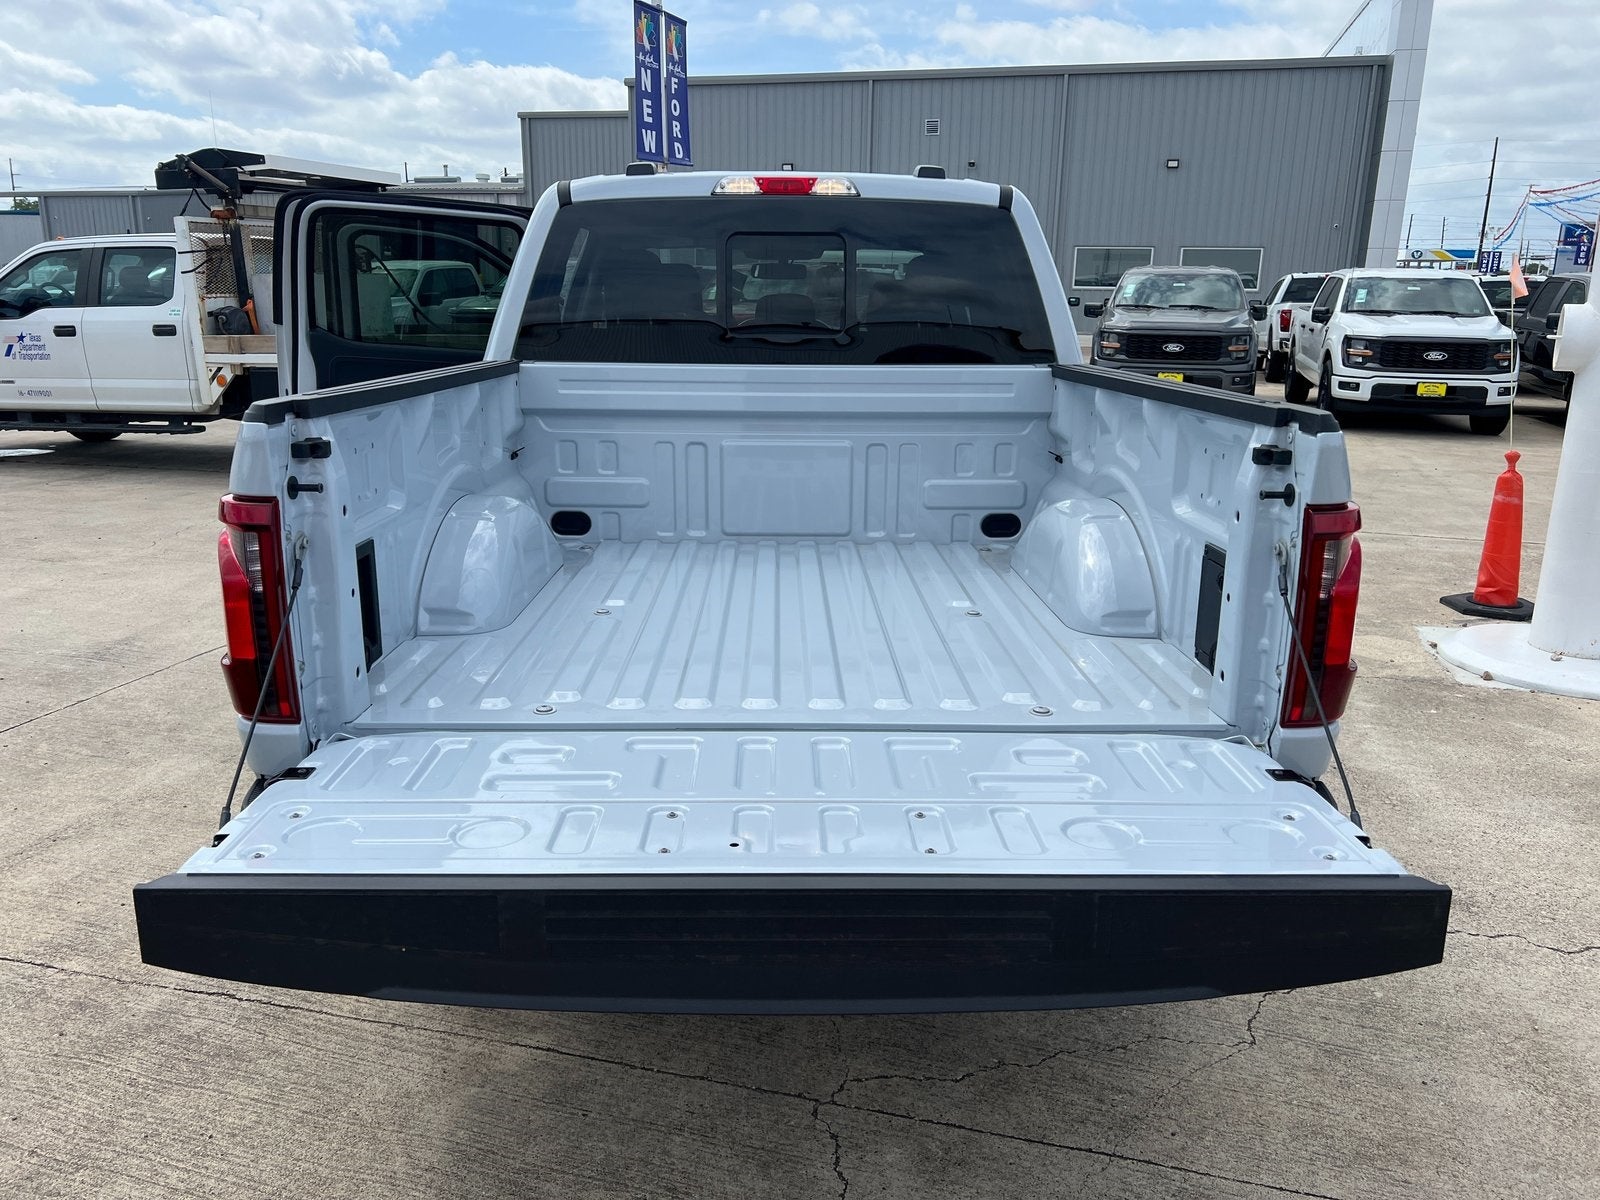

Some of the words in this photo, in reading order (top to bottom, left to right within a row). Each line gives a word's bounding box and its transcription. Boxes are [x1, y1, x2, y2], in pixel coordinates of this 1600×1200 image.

[641, 67, 656, 153] NEW
[671, 77, 684, 159] FORD
[29, 333, 41, 341] Texas
[19, 343, 46, 351] Department
[12, 351, 16, 360] of
[19, 351, 51, 361] Transportation
